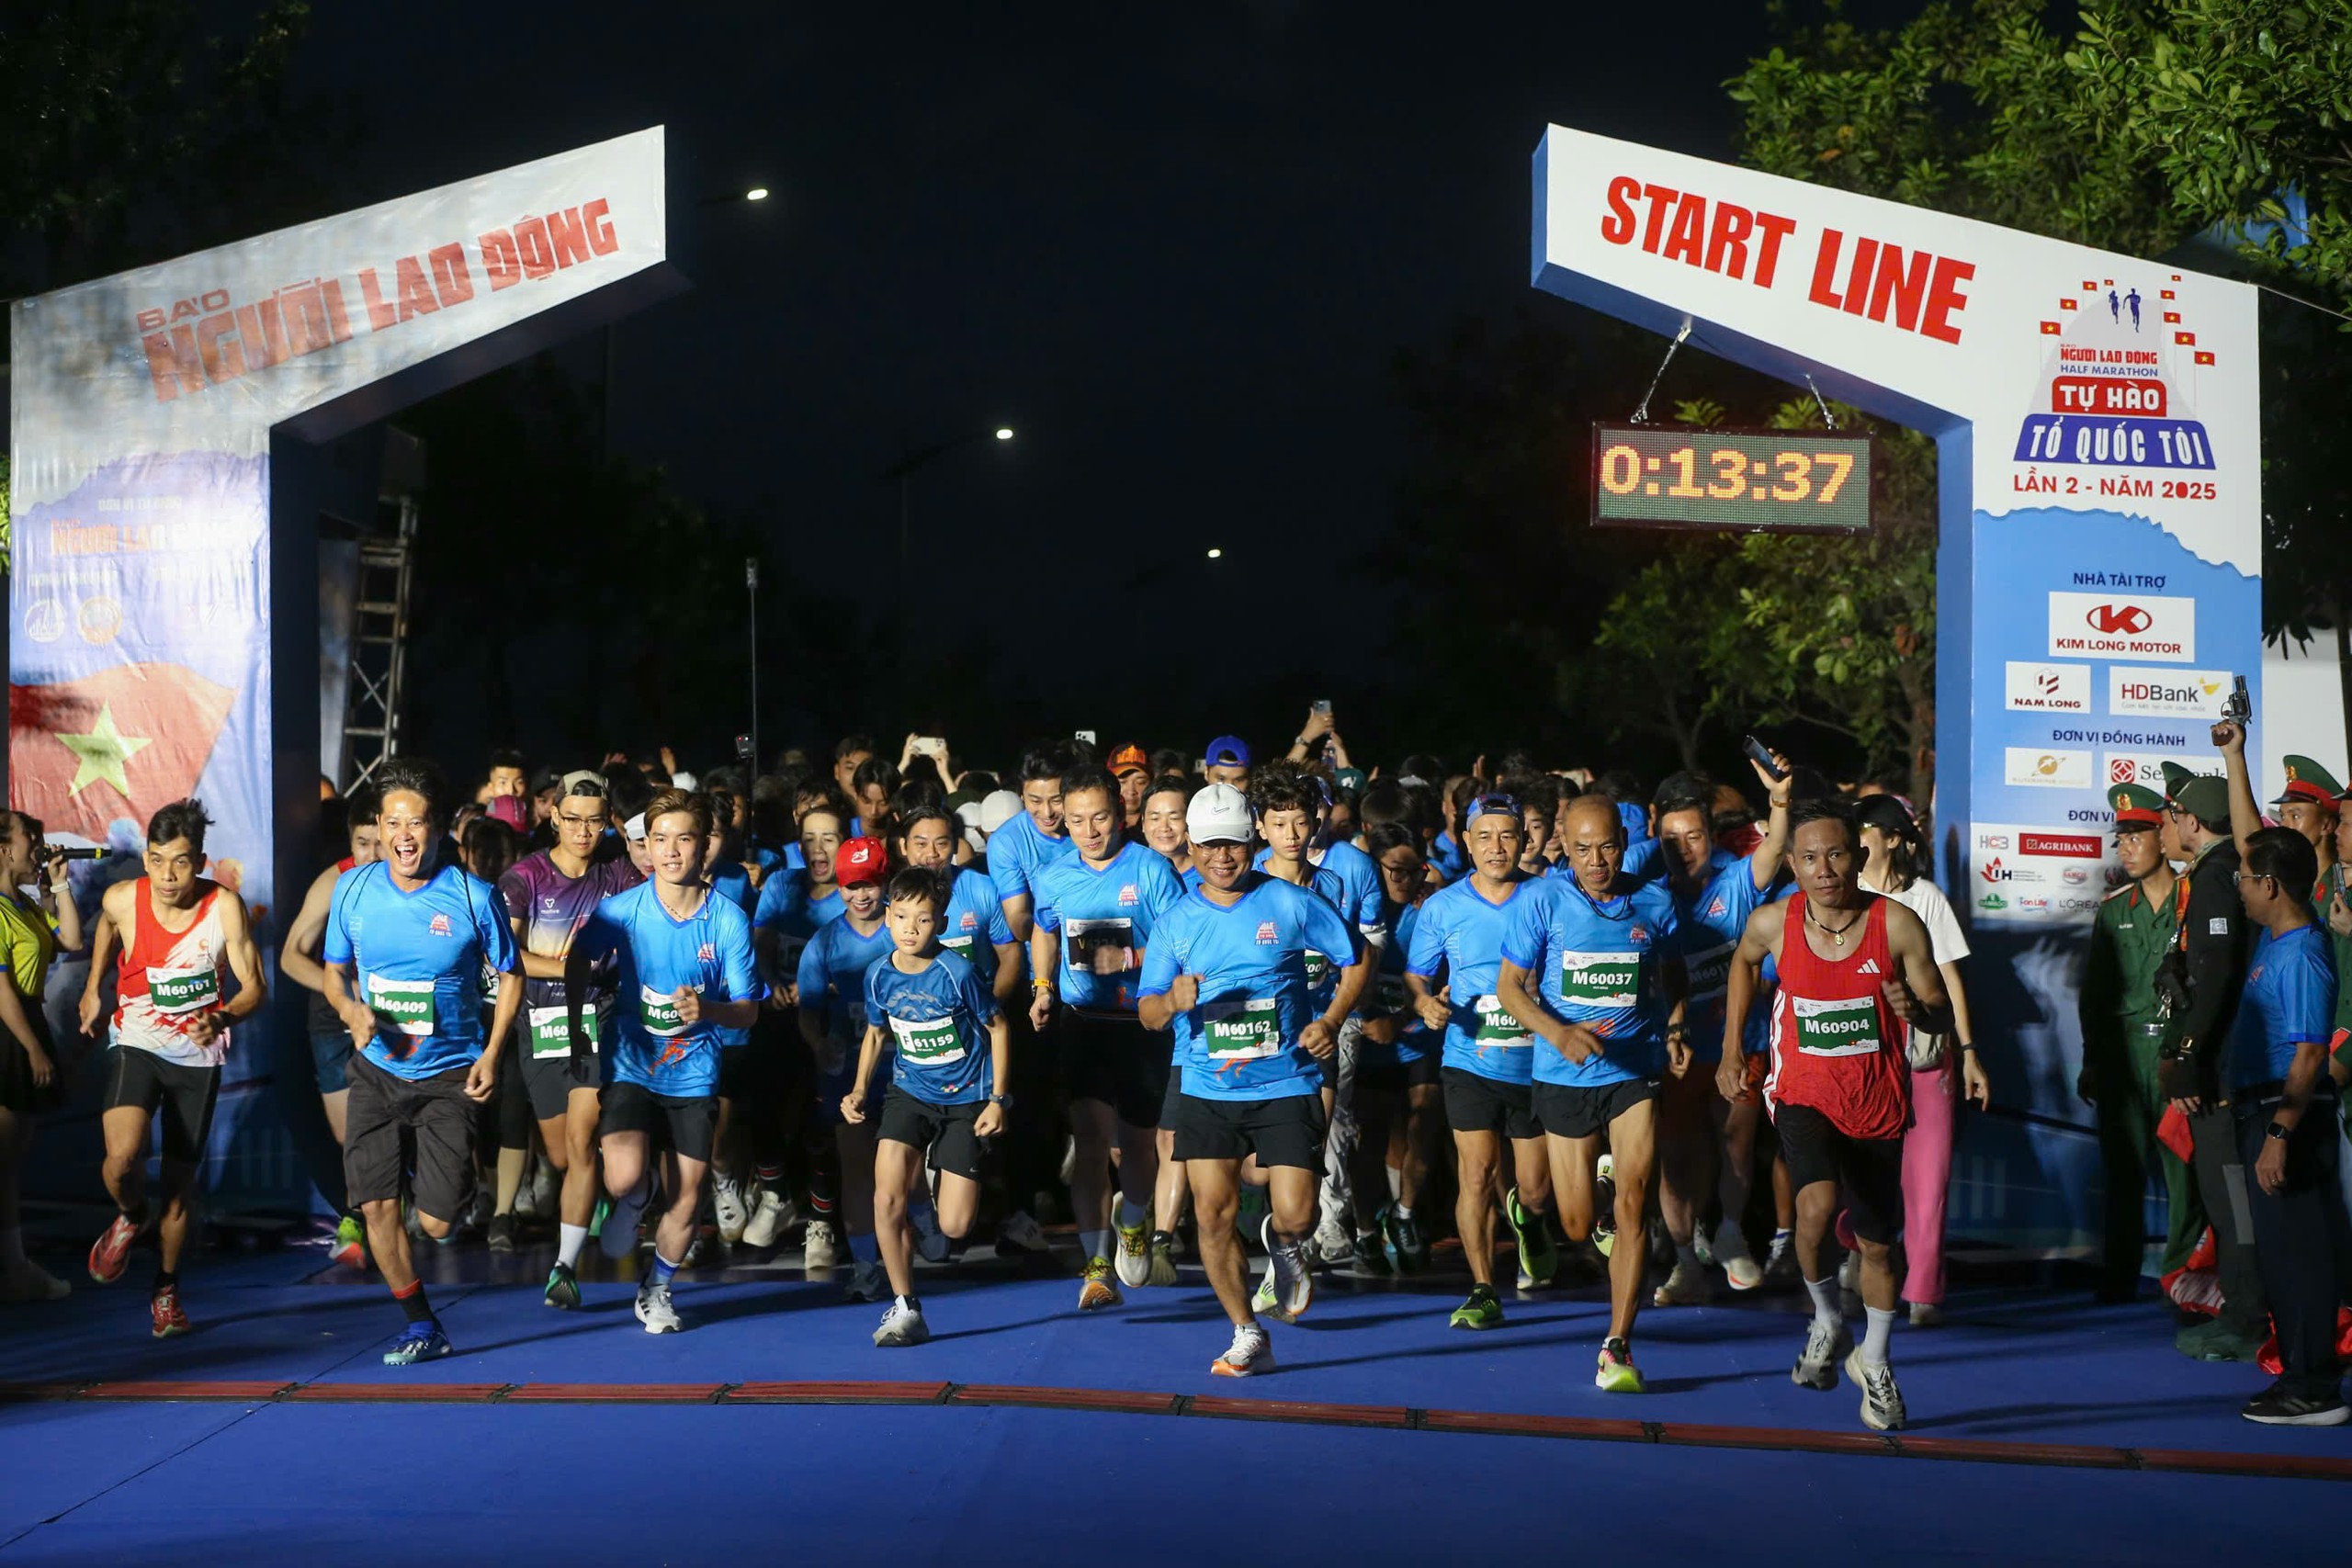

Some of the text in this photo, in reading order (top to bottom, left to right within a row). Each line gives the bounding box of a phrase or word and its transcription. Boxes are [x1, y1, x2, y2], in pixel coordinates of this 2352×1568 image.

[1601, 176, 1976, 344] START LINE
[141, 197, 619, 404] NGƯỜI LAO ĐỘNG
[2100, 350, 2121, 364] LAO
[2061, 365, 2158, 377] HALF MARATHON
[2059, 379, 2159, 412] TỰ HÀO
[2030, 416, 2206, 466] TỔ QUỐC TÔI
[1600, 446, 1854, 502] 0:13:37
[2014, 466, 2057, 493] LẦN
[2066, 476, 2078, 494] 2
[2100, 475, 2154, 497] NĂM
[2162, 481, 2217, 500] 2025
[2074, 572, 2166, 592] NHÀ TÀI TRỢ
[2056, 638, 2182, 654] KIM LONG MOTOR
[2121, 683, 2199, 703] HDBank
[2014, 698, 2081, 708] NAM LONG
[2052, 729, 2083, 741] ĐƠN
[2086, 731, 2098, 745] VỊ
[2146, 733, 2186, 746] HÀNH
[2068, 810, 2098, 822] ĐƠN
[2038, 840, 2094, 852] AGRIBANK
[1572, 971, 1633, 985] M60037
[157, 979, 209, 997] M60101
[374, 994, 427, 1013] M60409
[1214, 1021, 1271, 1037] M60162
[1805, 1019, 1870, 1034] M60904
